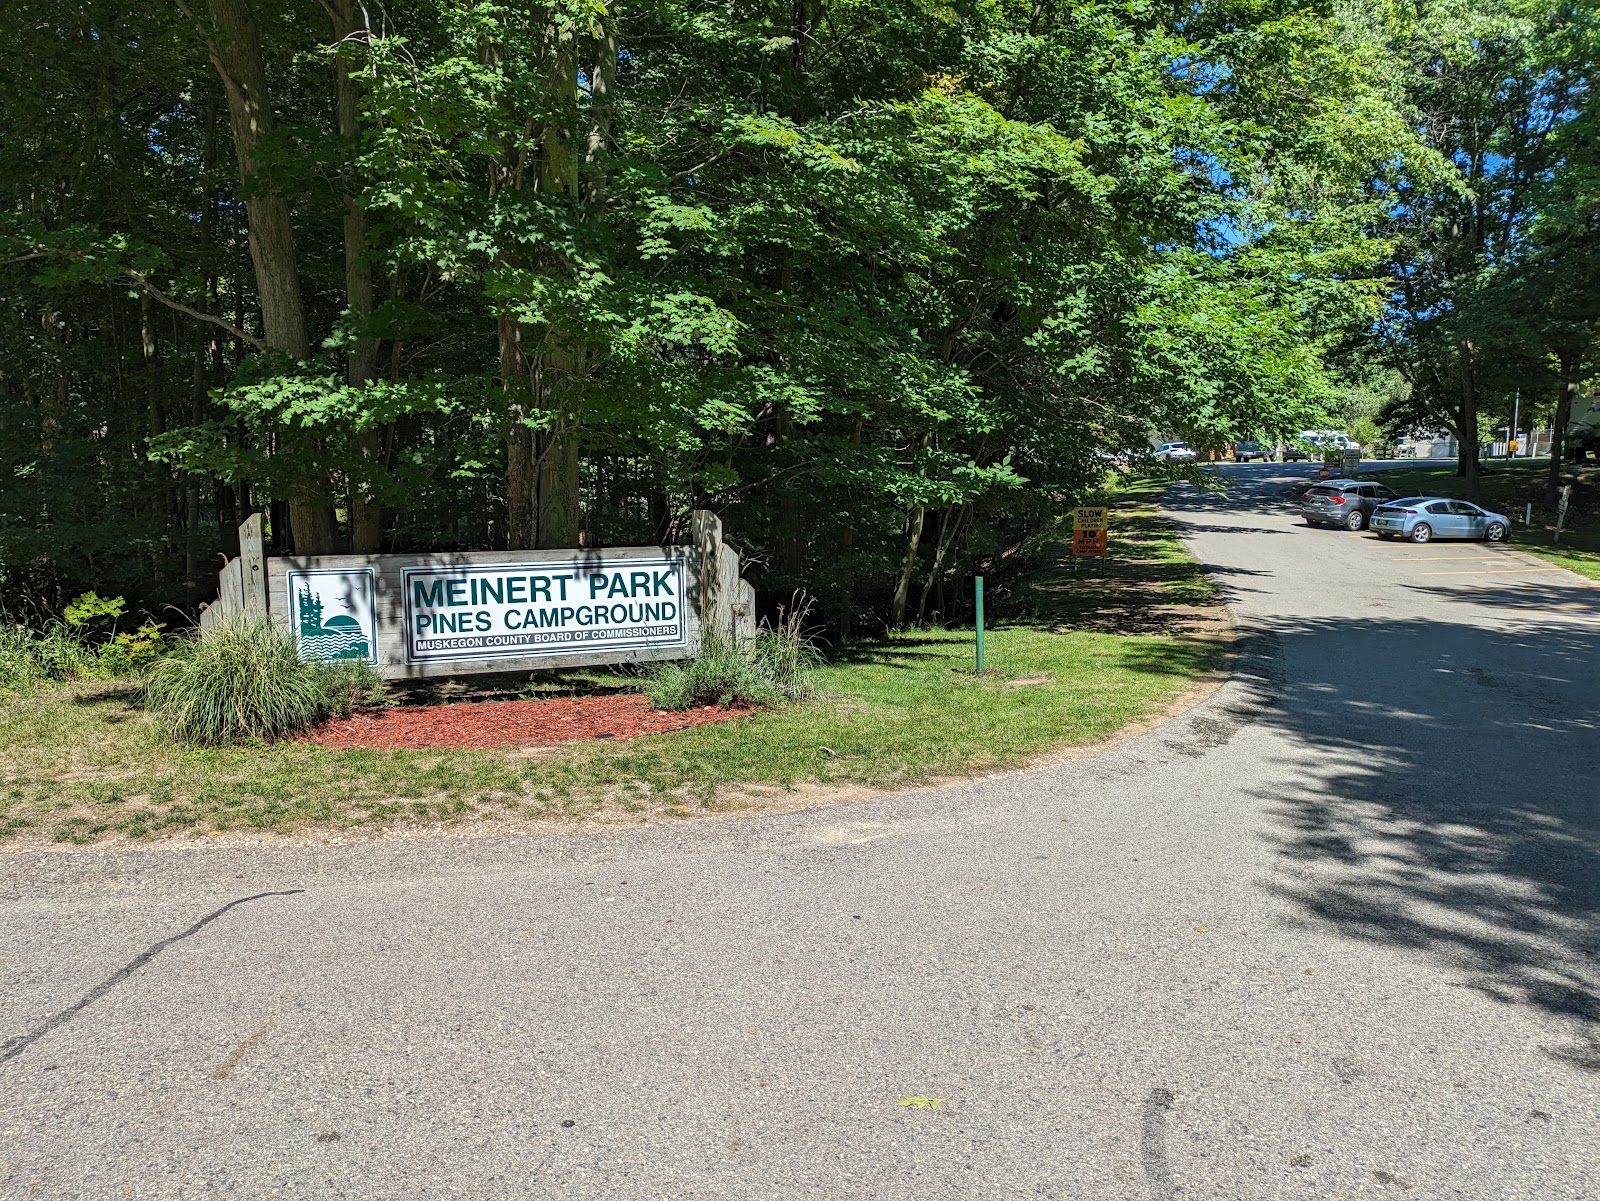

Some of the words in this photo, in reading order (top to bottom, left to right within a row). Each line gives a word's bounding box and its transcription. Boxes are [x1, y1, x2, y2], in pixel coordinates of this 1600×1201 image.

[414, 574, 573, 608] MEINERT
[589, 571, 675, 599] PARK
[415, 610, 492, 635] PINES
[504, 602, 677, 630] CAMPGROUND
[417, 637, 483, 650] MUSKEGON
[486, 634, 531, 646] COUNTY
[534, 632, 572, 643] BOARD
[574, 631, 589, 640] OF
[591, 626, 677, 639] COMMISSIONERS
